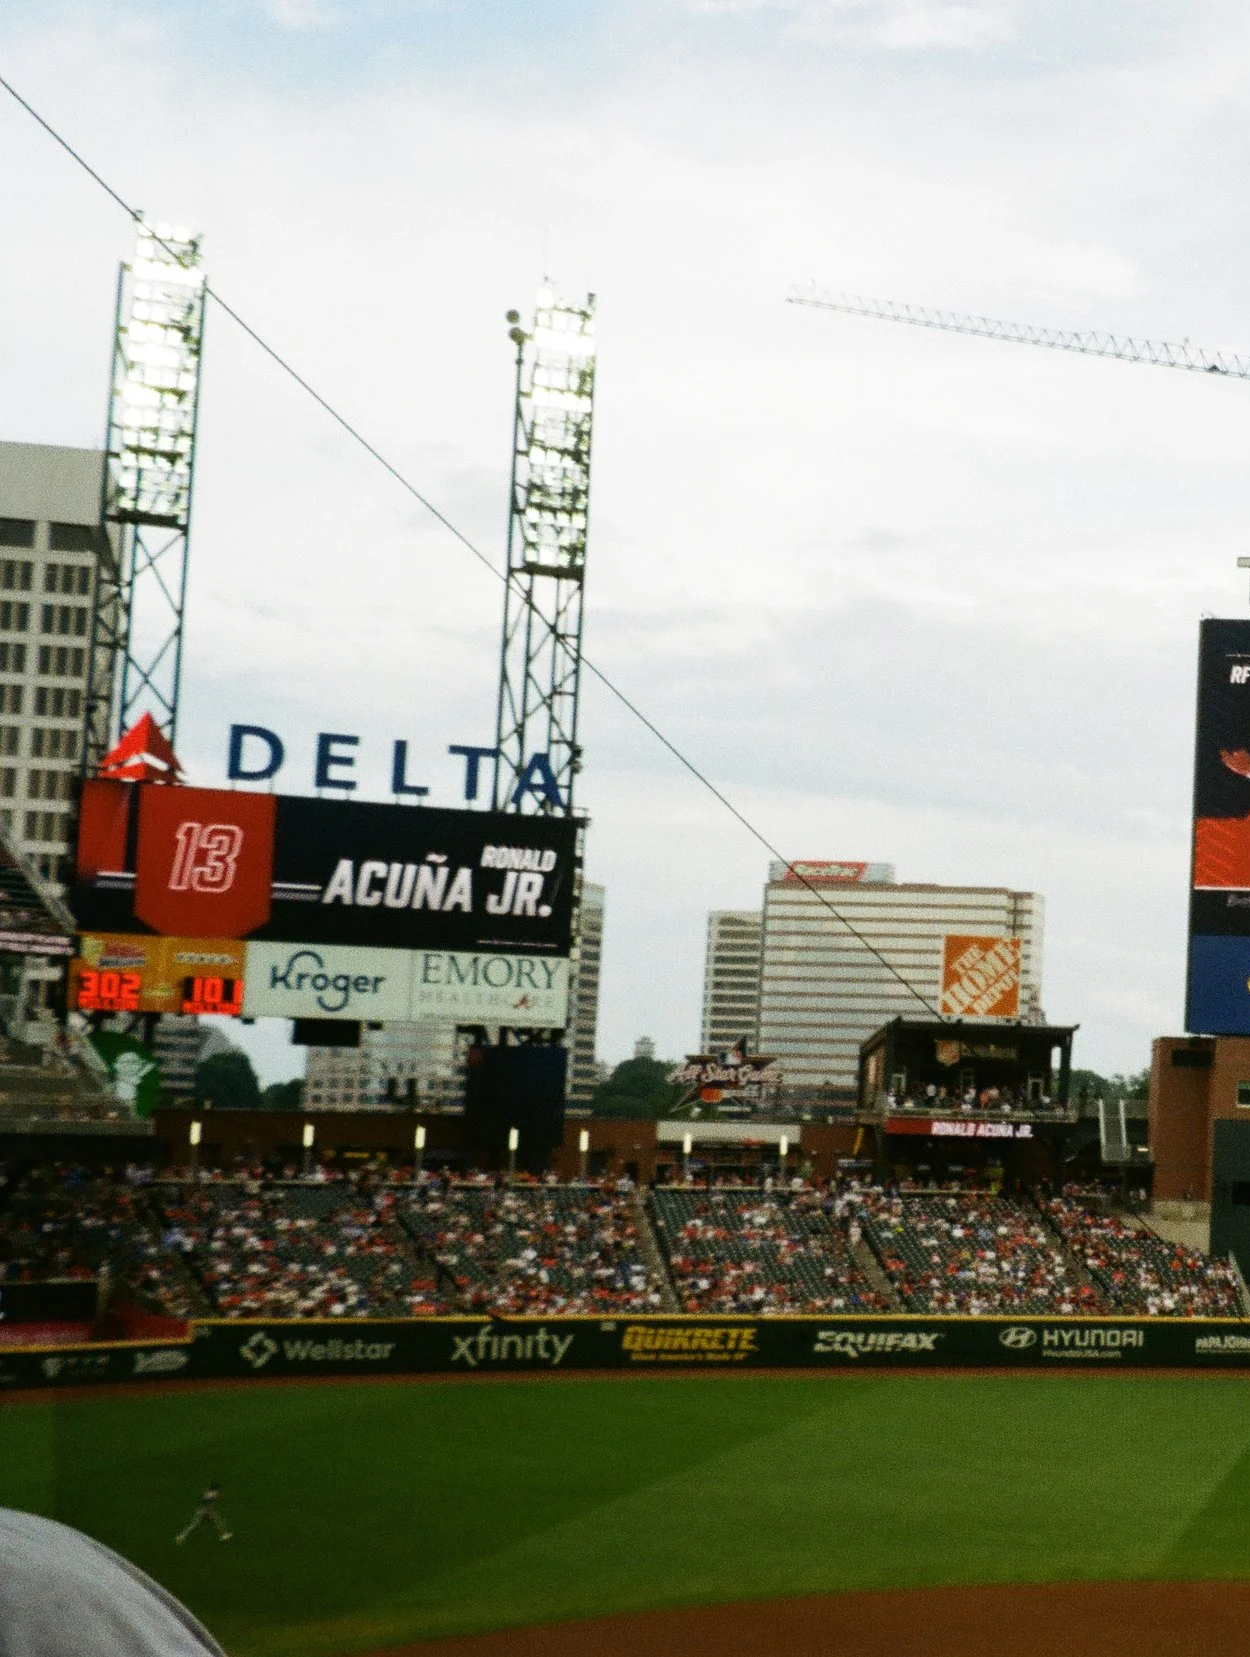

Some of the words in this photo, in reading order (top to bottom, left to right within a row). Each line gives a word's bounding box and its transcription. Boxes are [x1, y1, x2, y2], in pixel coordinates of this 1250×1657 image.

[226, 724, 565, 809] DELTA
[167, 822, 244, 893] 13
[480, 844, 557, 873] RONALD
[322, 852, 473, 914] ACUÑA
[485, 871, 554, 918] JR.
[79, 970, 141, 999] 302
[269, 950, 387, 1014] Kroger
[421, 953, 562, 989] EMORY
[942, 937, 1021, 1016] HOME
[931, 1121, 976, 1137] RONALD
[283, 1339, 397, 1361] Wellstar
[451, 1325, 574, 1367] xfinity
[622, 1325, 759, 1352] QUIKRETE
[813, 1330, 940, 1358] EQUIFAX
[1042, 1329, 1144, 1348] HYUNDAI
